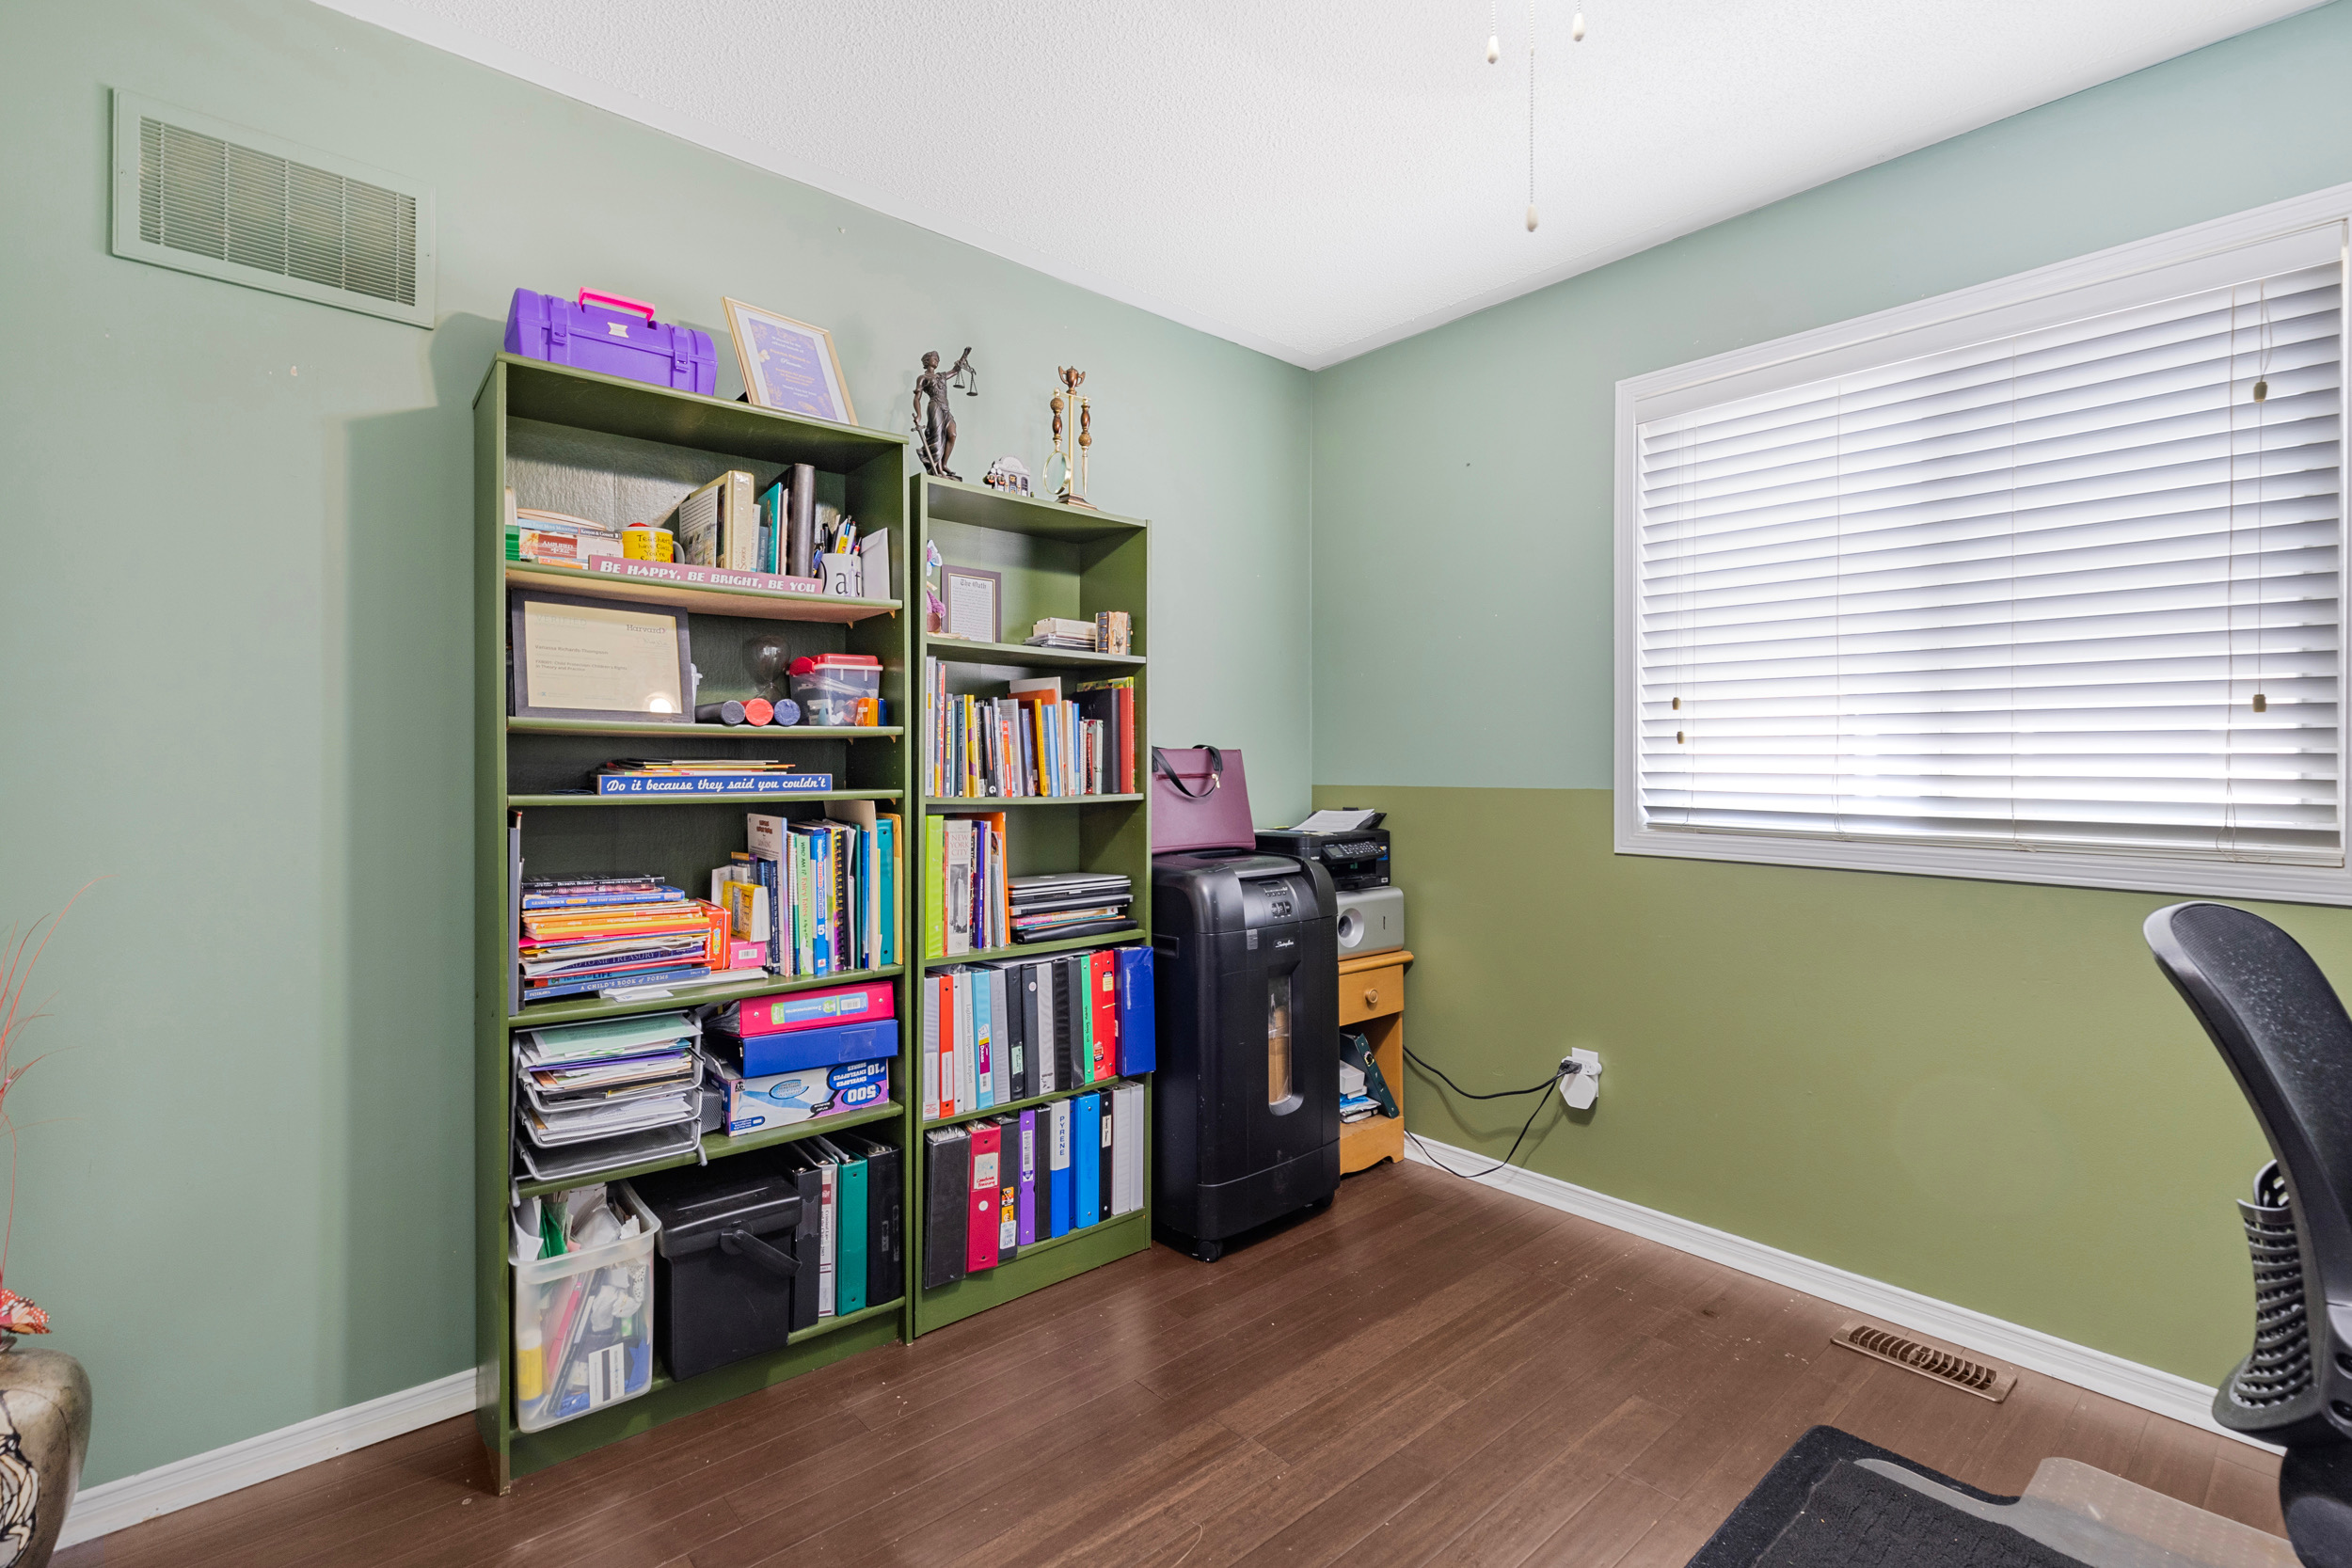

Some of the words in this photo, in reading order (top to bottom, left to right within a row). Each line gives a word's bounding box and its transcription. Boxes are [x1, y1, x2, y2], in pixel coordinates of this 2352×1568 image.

[627, 566, 680, 580] HAPPY,
[687, 571, 705, 582] BE
[711, 573, 762, 588] BRIGHT,
[768, 580, 784, 590] BE
[790, 583, 815, 593] YOU
[973, 581, 987, 589] Oath
[606, 780, 626, 792] Do
[631, 780, 641, 791] it
[646, 779, 693, 791] because
[698, 778, 724, 792] they
[727, 778, 754, 789] said
[758, 780, 779, 792] you
[782, 776, 826, 789] couldn't
[801, 858, 806, 867] AM
[818, 924, 825, 935] 5
[613, 952, 654, 963] TREASURY
[587, 981, 616, 989] CHILD'S
[617, 979, 636, 987] BOOK
[847, 1062, 866, 1071] SOBRES
[868, 1063, 885, 1075] #10
[833, 1069, 866, 1081] ENVELOPPES
[836, 1076, 867, 1087] ENVELOPES
[847, 1085, 876, 1103] 500
